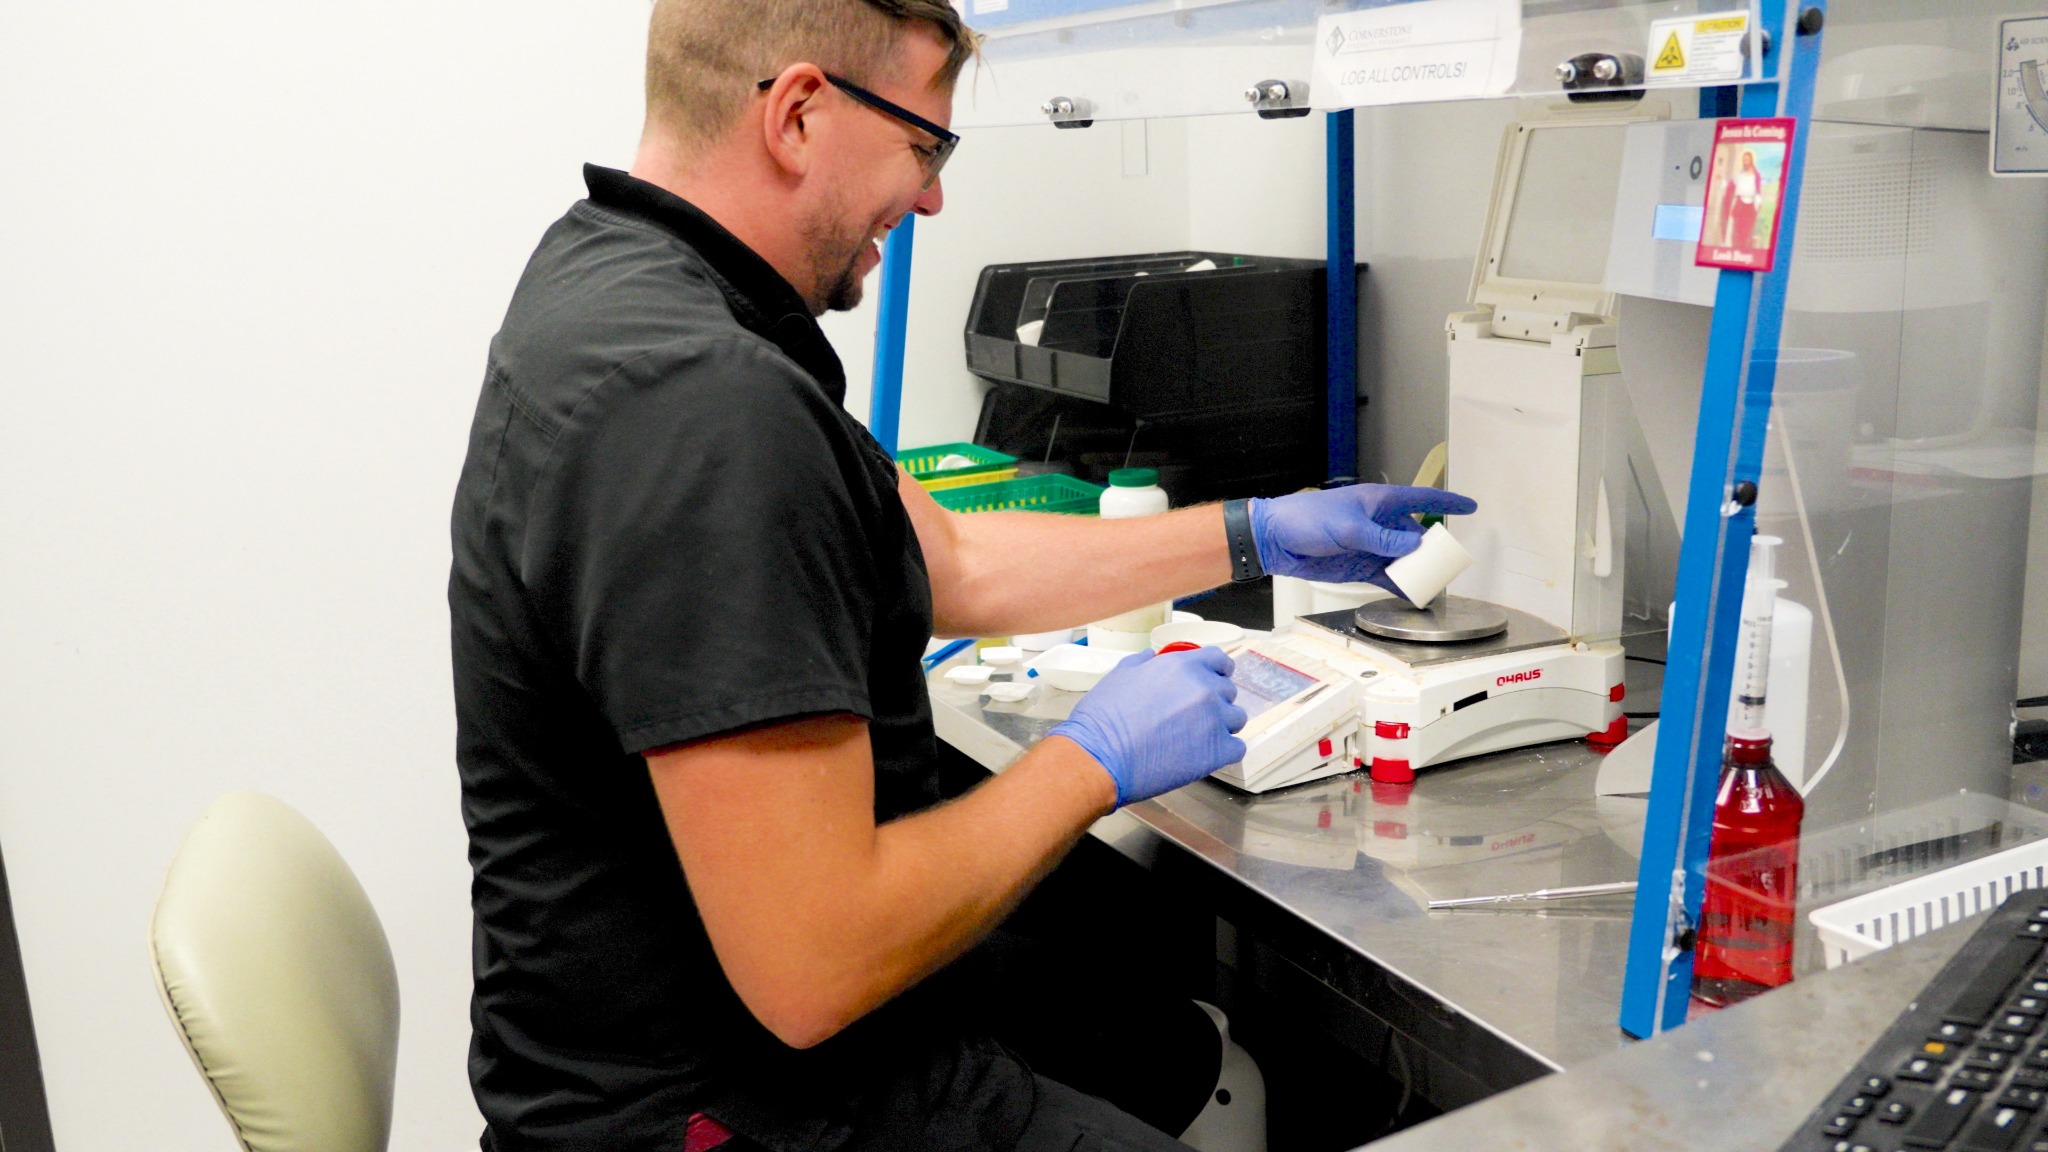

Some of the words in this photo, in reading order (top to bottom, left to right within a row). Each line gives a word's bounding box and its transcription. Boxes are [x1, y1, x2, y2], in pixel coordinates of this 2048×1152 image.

[1349, 25, 1413, 41] CORNERSTONE
[1341, 70, 1366, 85] LOG
[1367, 67, 1389, 83] ALL
[1391, 62, 1467, 81] CONTROLS!
[1496, 668, 1541, 687] OHAUS
